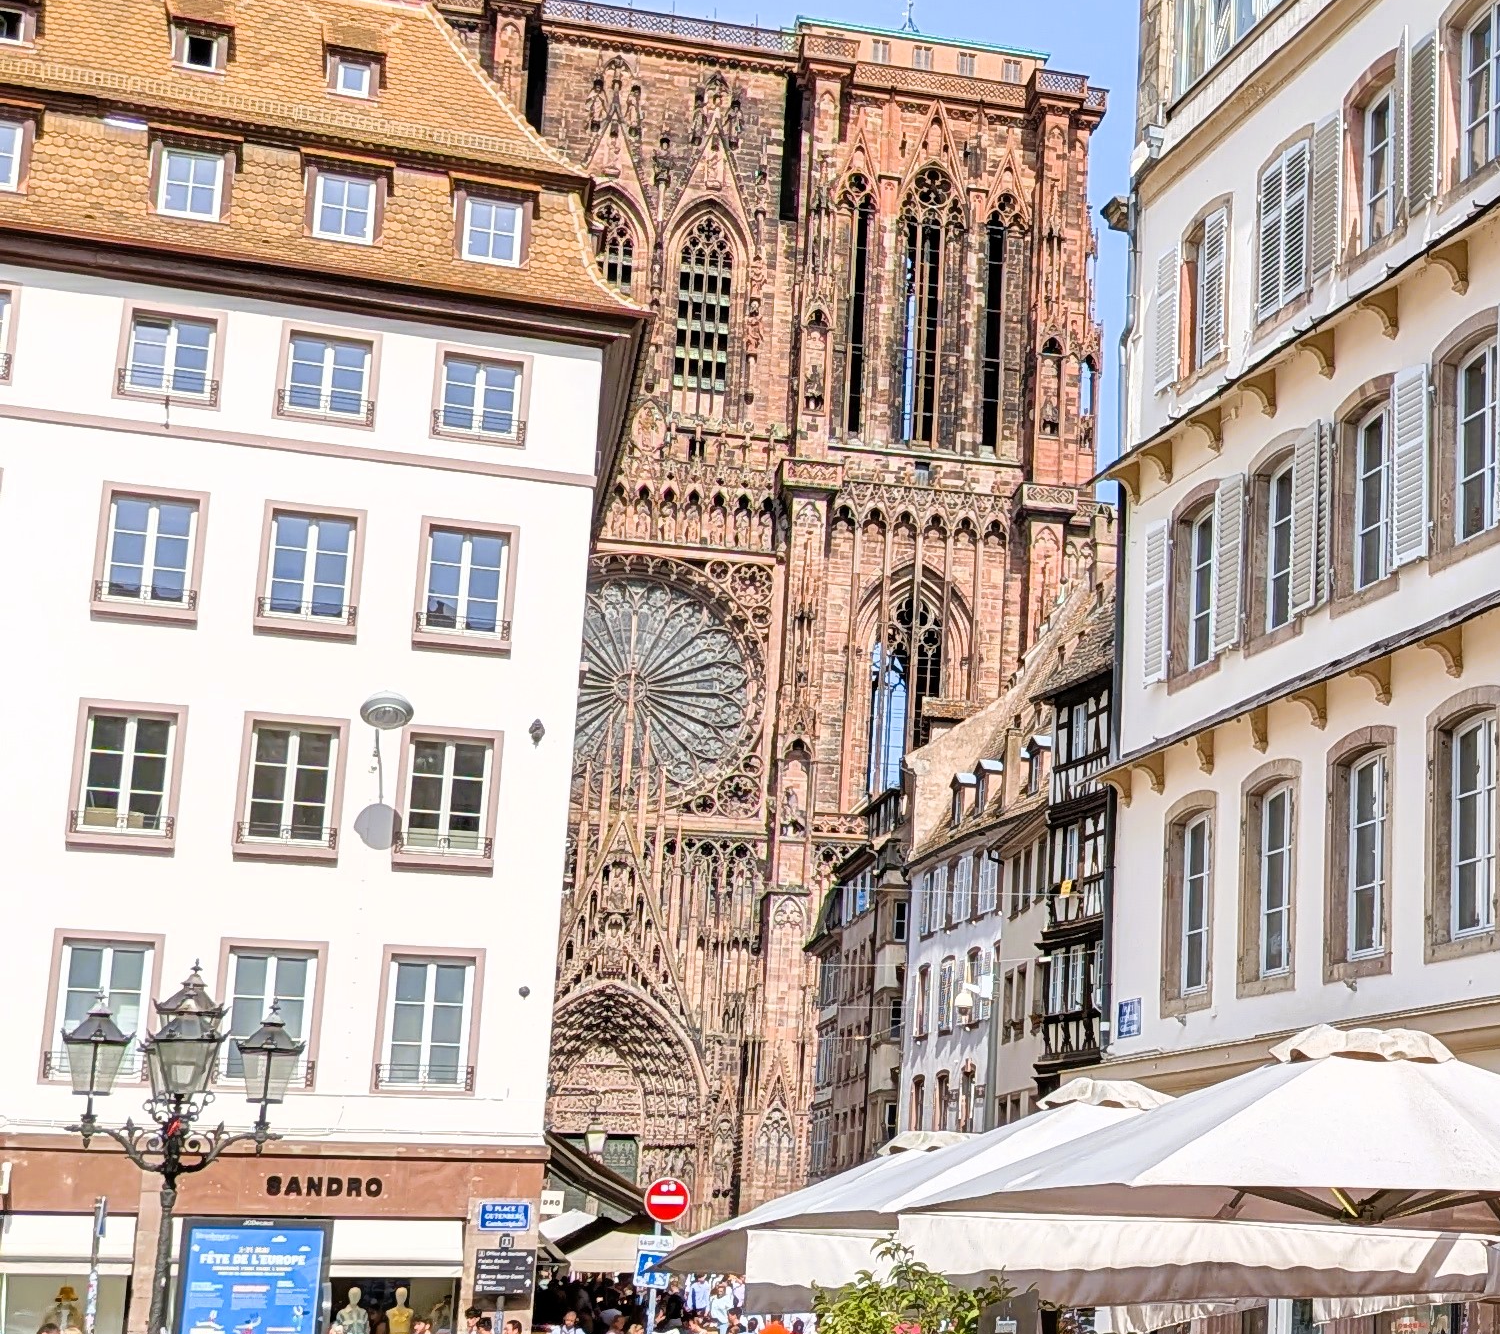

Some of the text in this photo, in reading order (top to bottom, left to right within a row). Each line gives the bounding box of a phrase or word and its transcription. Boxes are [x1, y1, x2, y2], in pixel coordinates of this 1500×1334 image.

[266, 1175, 383, 1198] SANDRO
[199, 1250, 307, 1266] FÊTE DE L'EUROPE
